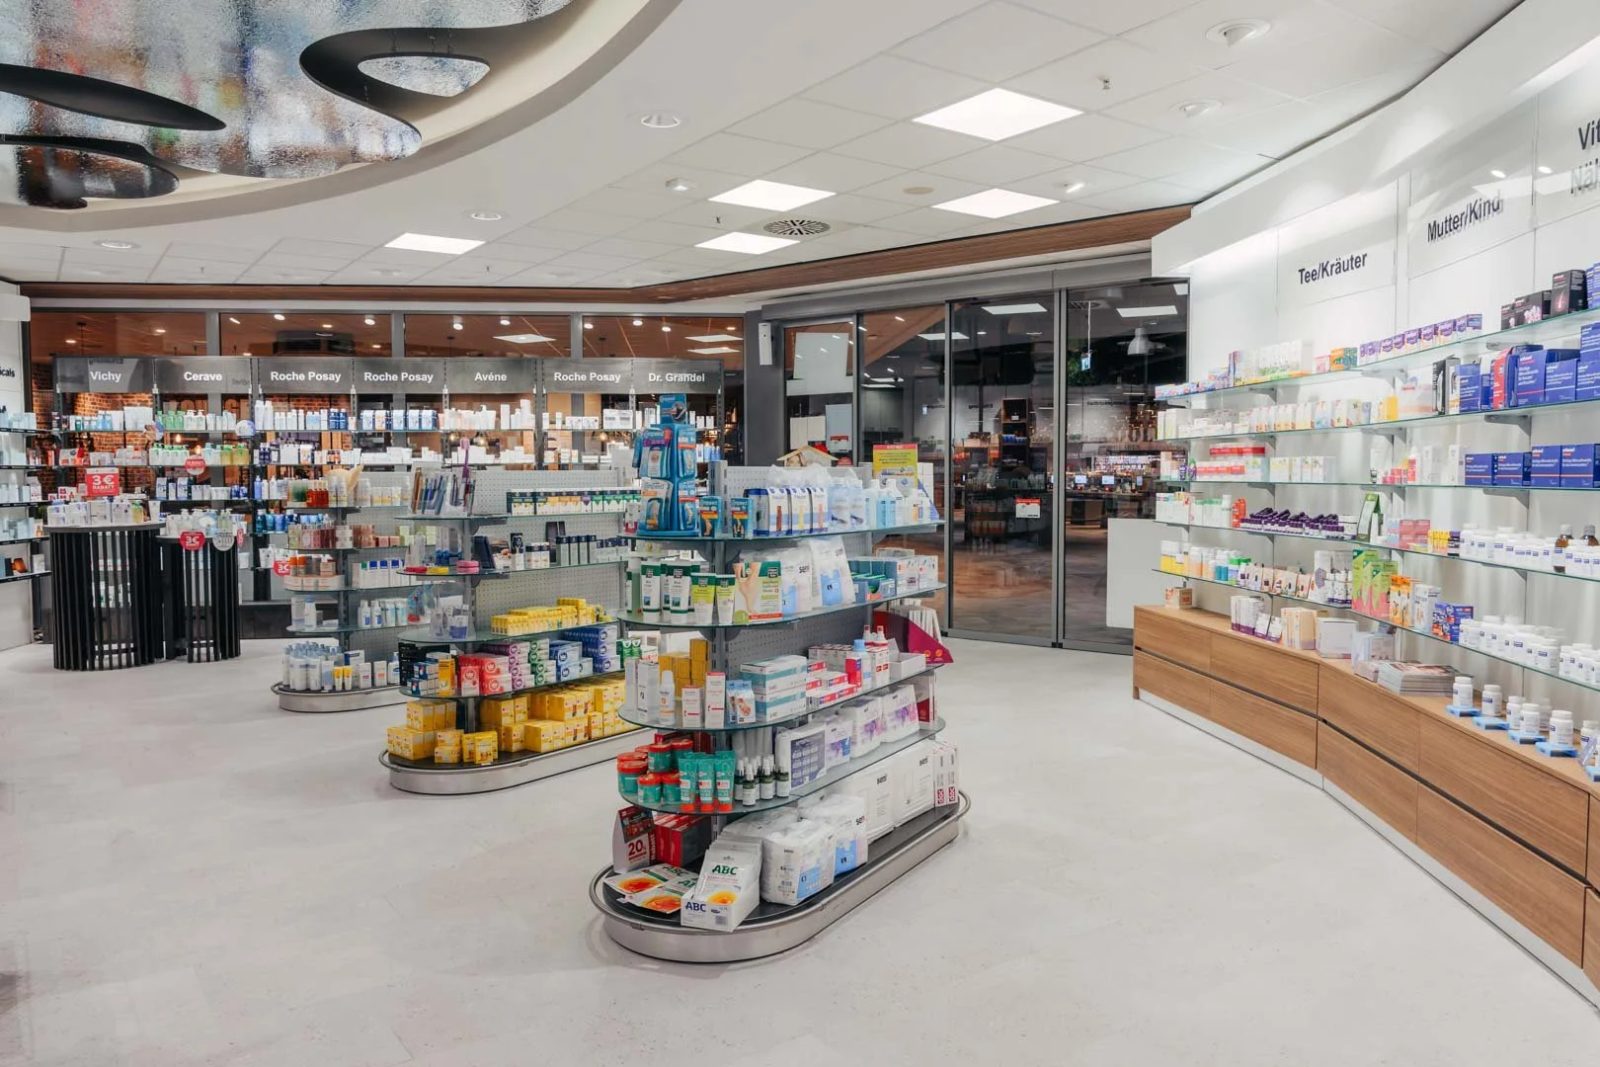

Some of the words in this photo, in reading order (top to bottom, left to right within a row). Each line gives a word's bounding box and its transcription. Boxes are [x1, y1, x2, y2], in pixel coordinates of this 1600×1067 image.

[1427, 189, 1502, 243] Mutter/Kind
[1298, 252, 1367, 285] Tee/Kräuter
[90, 371, 121, 383] Vichy
[184, 371, 222, 381] Cerave
[270, 371, 305, 381] Roche
[308, 372, 341, 383] Posay
[364, 372, 398, 381] Roche
[401, 372, 434, 384] Posay
[554, 372, 587, 382] Roche
[590, 373, 621, 383] Posay
[649, 372, 663, 382] Dr.
[665, 372, 705, 382] Grandel
[712, 864, 738, 876] ABC
[685, 901, 707, 912] ABC
